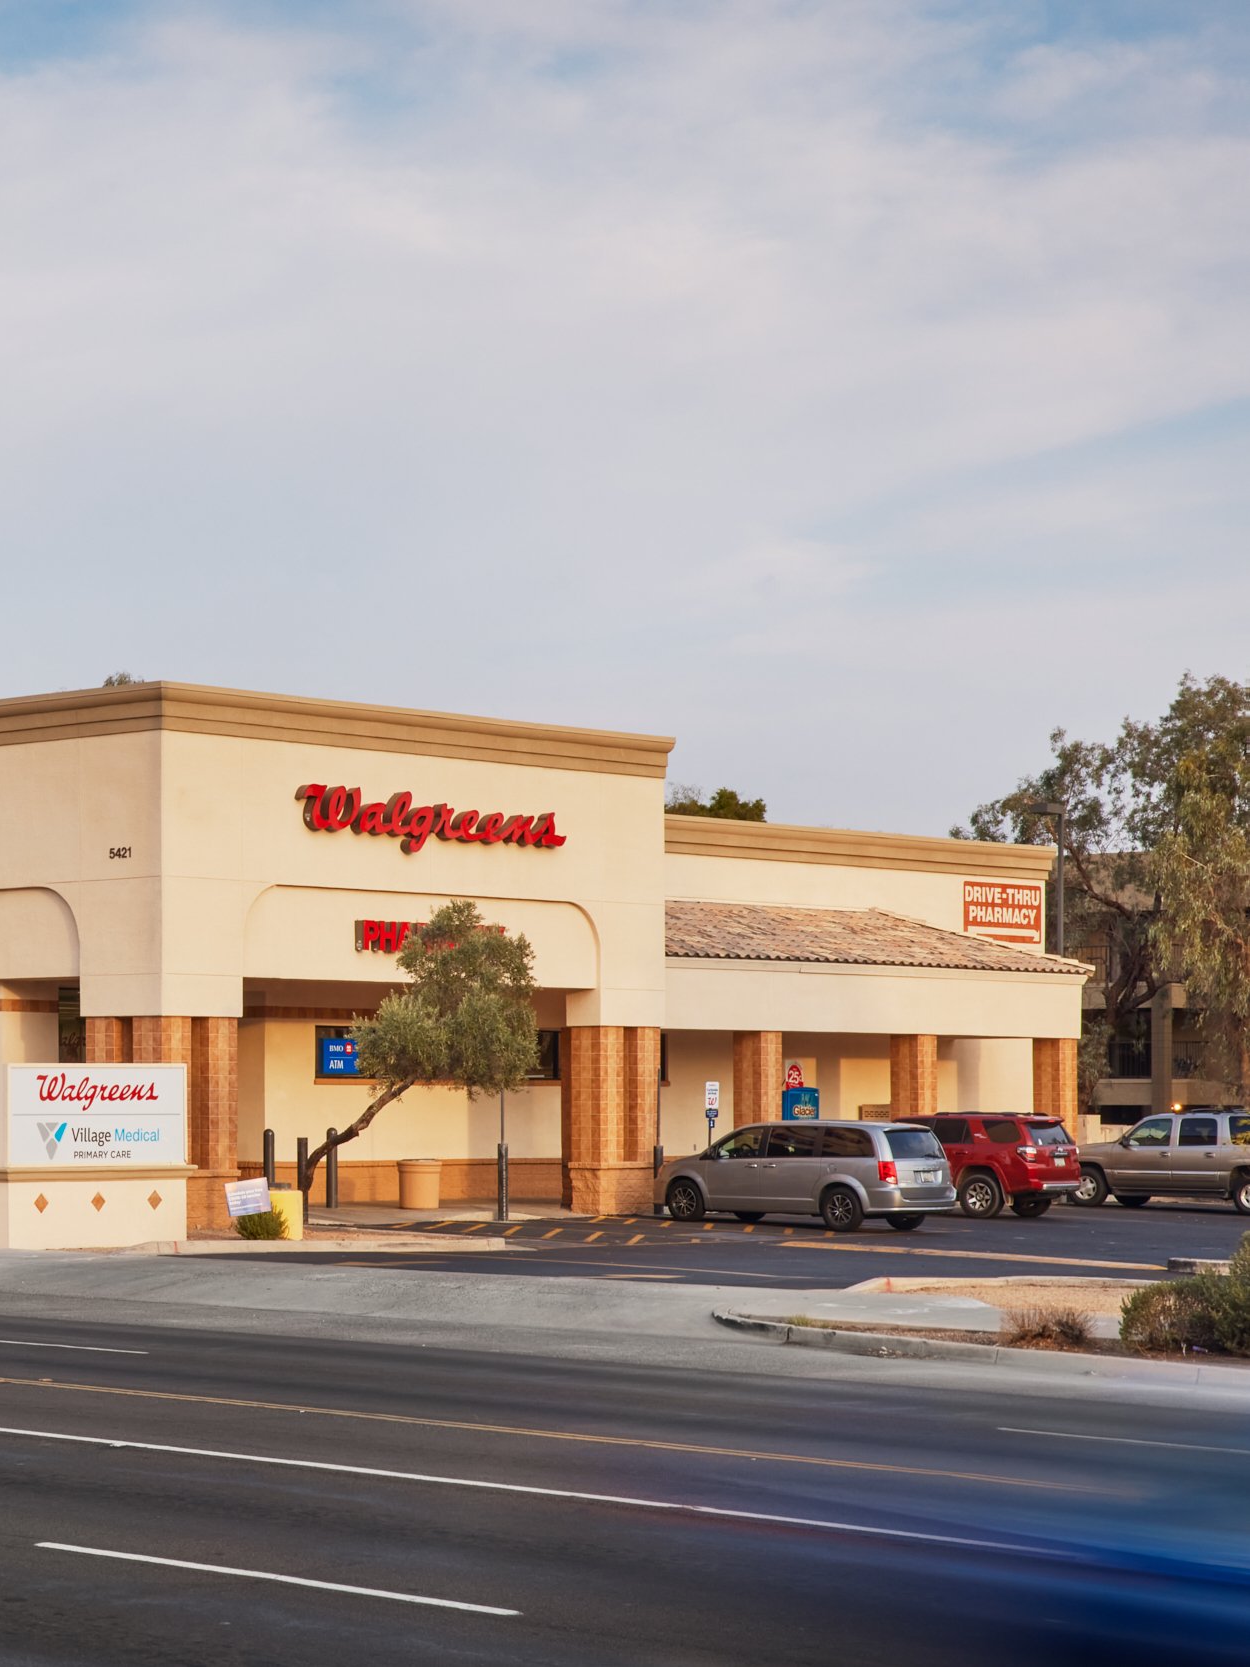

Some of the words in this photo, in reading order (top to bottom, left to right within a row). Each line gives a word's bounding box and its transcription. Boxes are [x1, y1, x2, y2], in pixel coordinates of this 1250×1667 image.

[294, 783, 567, 856] Walgreens
[108, 846, 132, 860] 5421
[964, 884, 1041, 906] DRIVE-THRU
[968, 905, 1037, 926] PHARMACY
[328, 1060, 344, 1070] ATM
[36, 1073, 159, 1112] Walgreens
[71, 1127, 112, 1147] Village
[114, 1127, 160, 1142] Medical
[73, 1150, 108, 1160] PRIMARY
[110, 1150, 132, 1159] CARE
